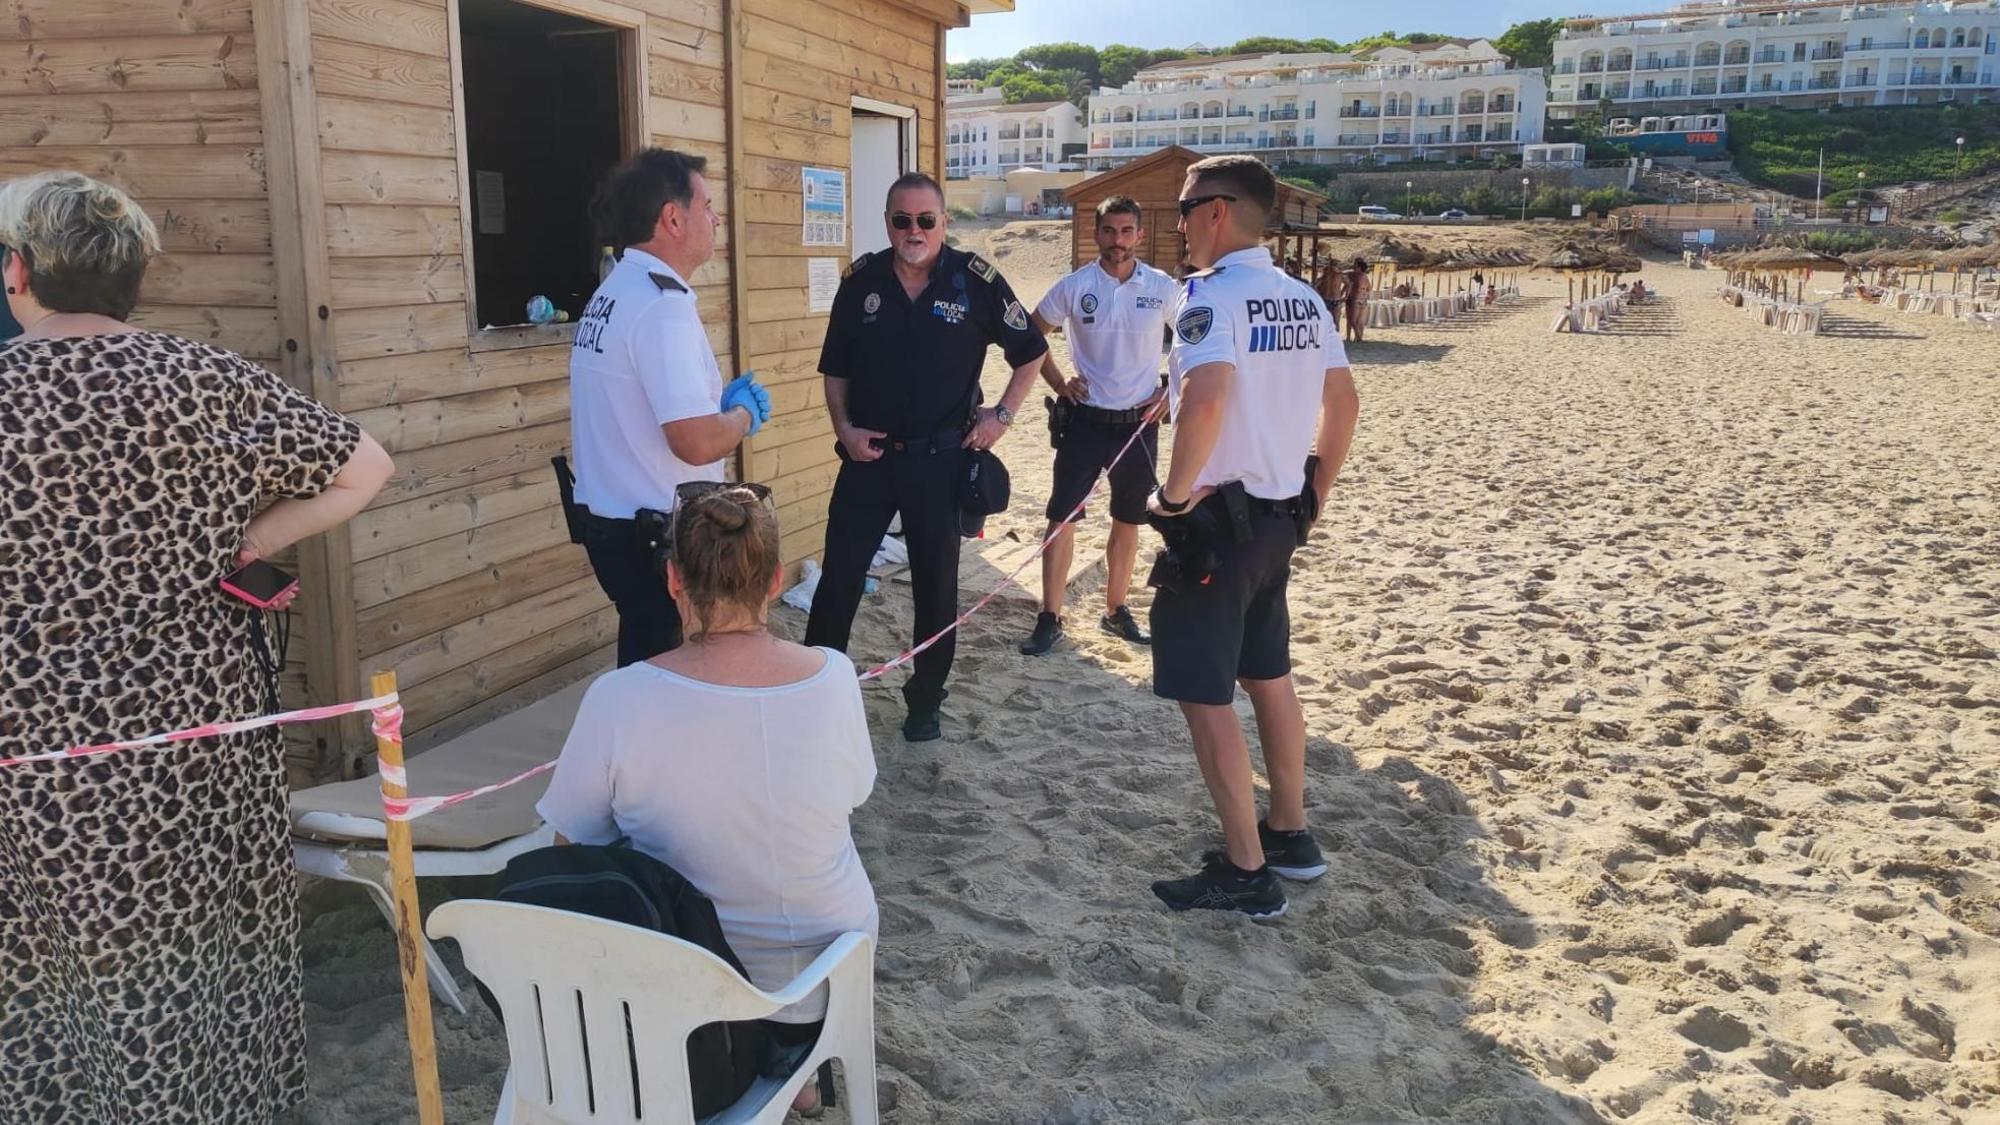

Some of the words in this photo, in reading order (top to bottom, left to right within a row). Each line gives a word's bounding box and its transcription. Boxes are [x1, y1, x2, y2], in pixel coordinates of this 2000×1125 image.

[1686, 132, 1718, 144] VIVA
[1246, 299, 1320, 322] POLICIA
[1277, 324, 1320, 351] LOCAL
